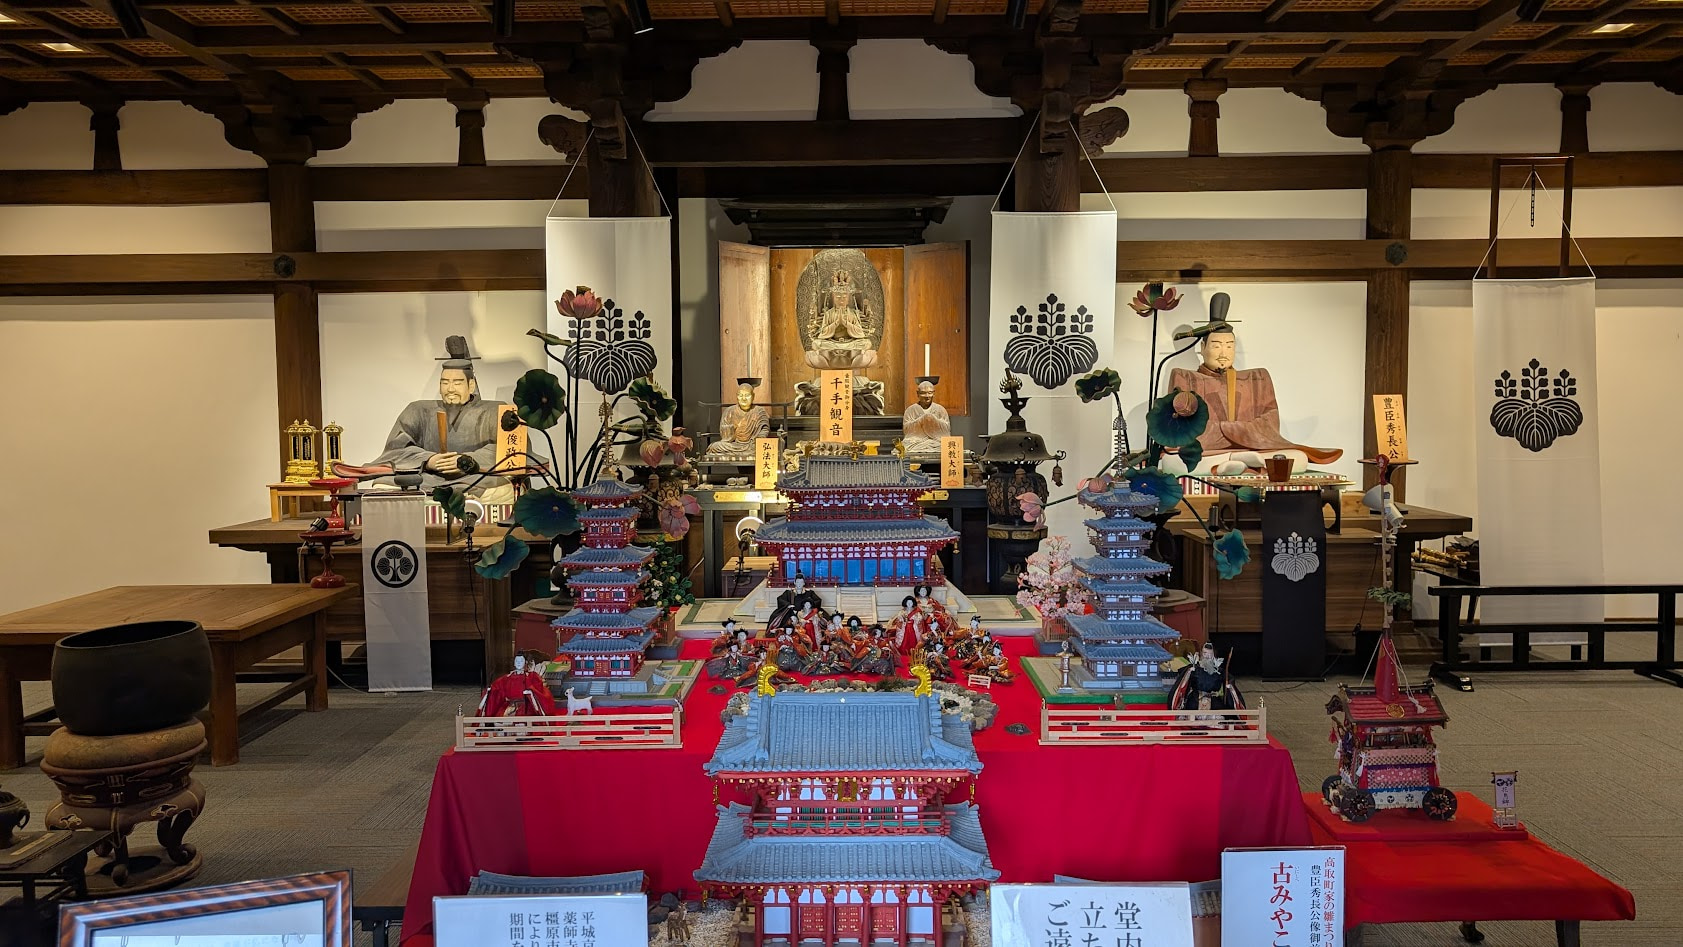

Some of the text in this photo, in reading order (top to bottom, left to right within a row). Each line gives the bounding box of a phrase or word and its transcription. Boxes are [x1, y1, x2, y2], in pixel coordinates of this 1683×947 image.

[829, 377, 843, 436] 千手観音
[1383, 397, 1400, 459] 豊臣秀長公
[762, 442, 772, 479] 弘法大師
[947, 440, 957, 477] 興教大師
